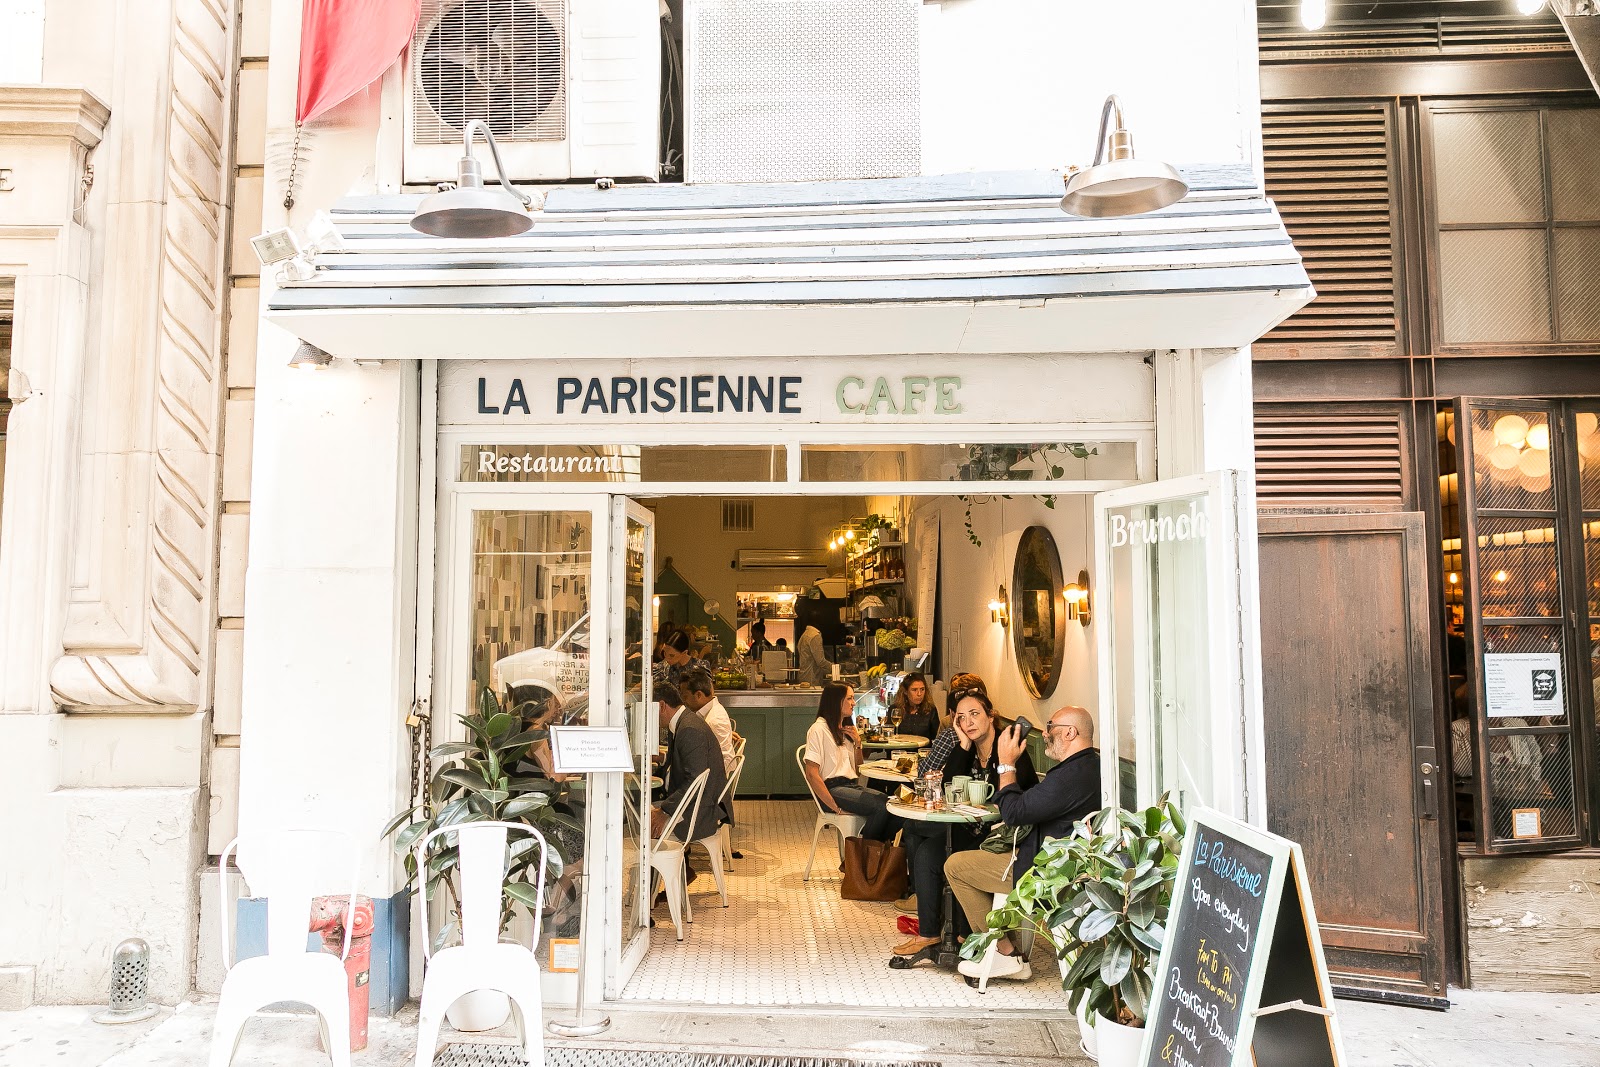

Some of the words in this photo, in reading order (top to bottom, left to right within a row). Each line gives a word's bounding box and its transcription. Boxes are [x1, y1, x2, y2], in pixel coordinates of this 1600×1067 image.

[477, 377, 532, 415] LA
[556, 375, 803, 415] PARISIENNE
[834, 376, 963, 415] CAFE
[477, 451, 622, 473] Restaurant
[1110, 500, 1210, 548] Brunch
[1194, 832, 1209, 866] La
[1208, 841, 1262, 898] Parisienne
[1161, 1034, 1175, 1064] &
